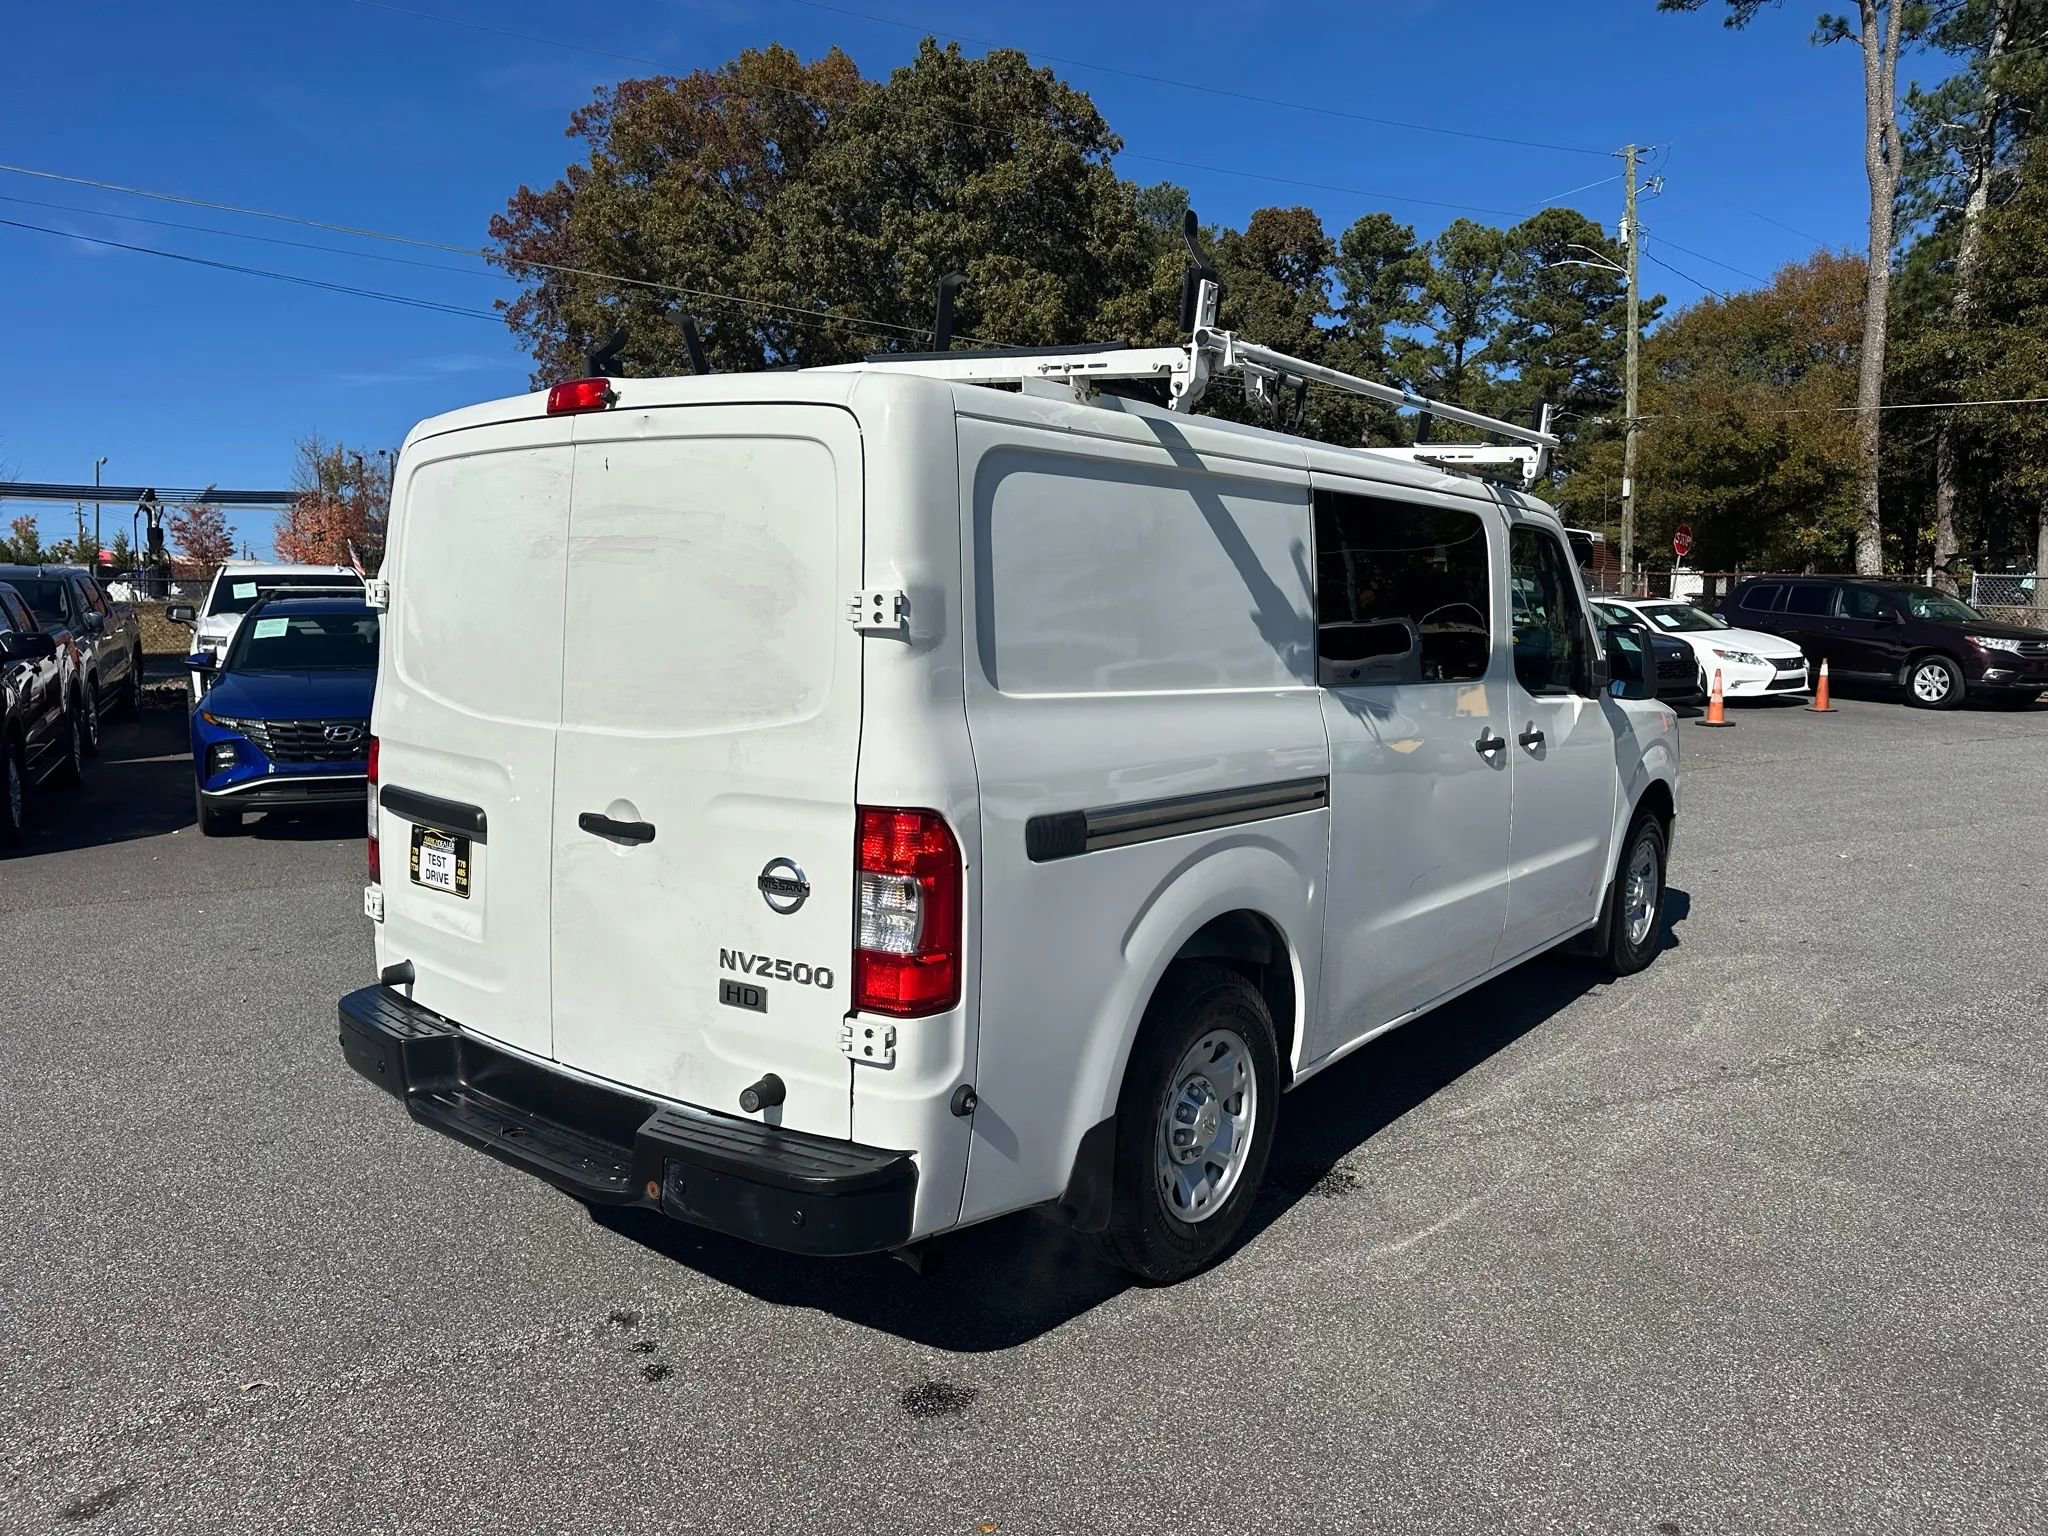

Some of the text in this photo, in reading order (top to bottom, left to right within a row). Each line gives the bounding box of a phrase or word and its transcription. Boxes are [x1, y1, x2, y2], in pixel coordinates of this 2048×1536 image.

[1675, 532, 1692, 547] STOP
[427, 853, 447, 868] TEST
[425, 868, 449, 885] DRIVE
[761, 878, 803, 893] NISSAN
[719, 947, 835, 990] NV2500
[726, 985, 759, 1007] HD
